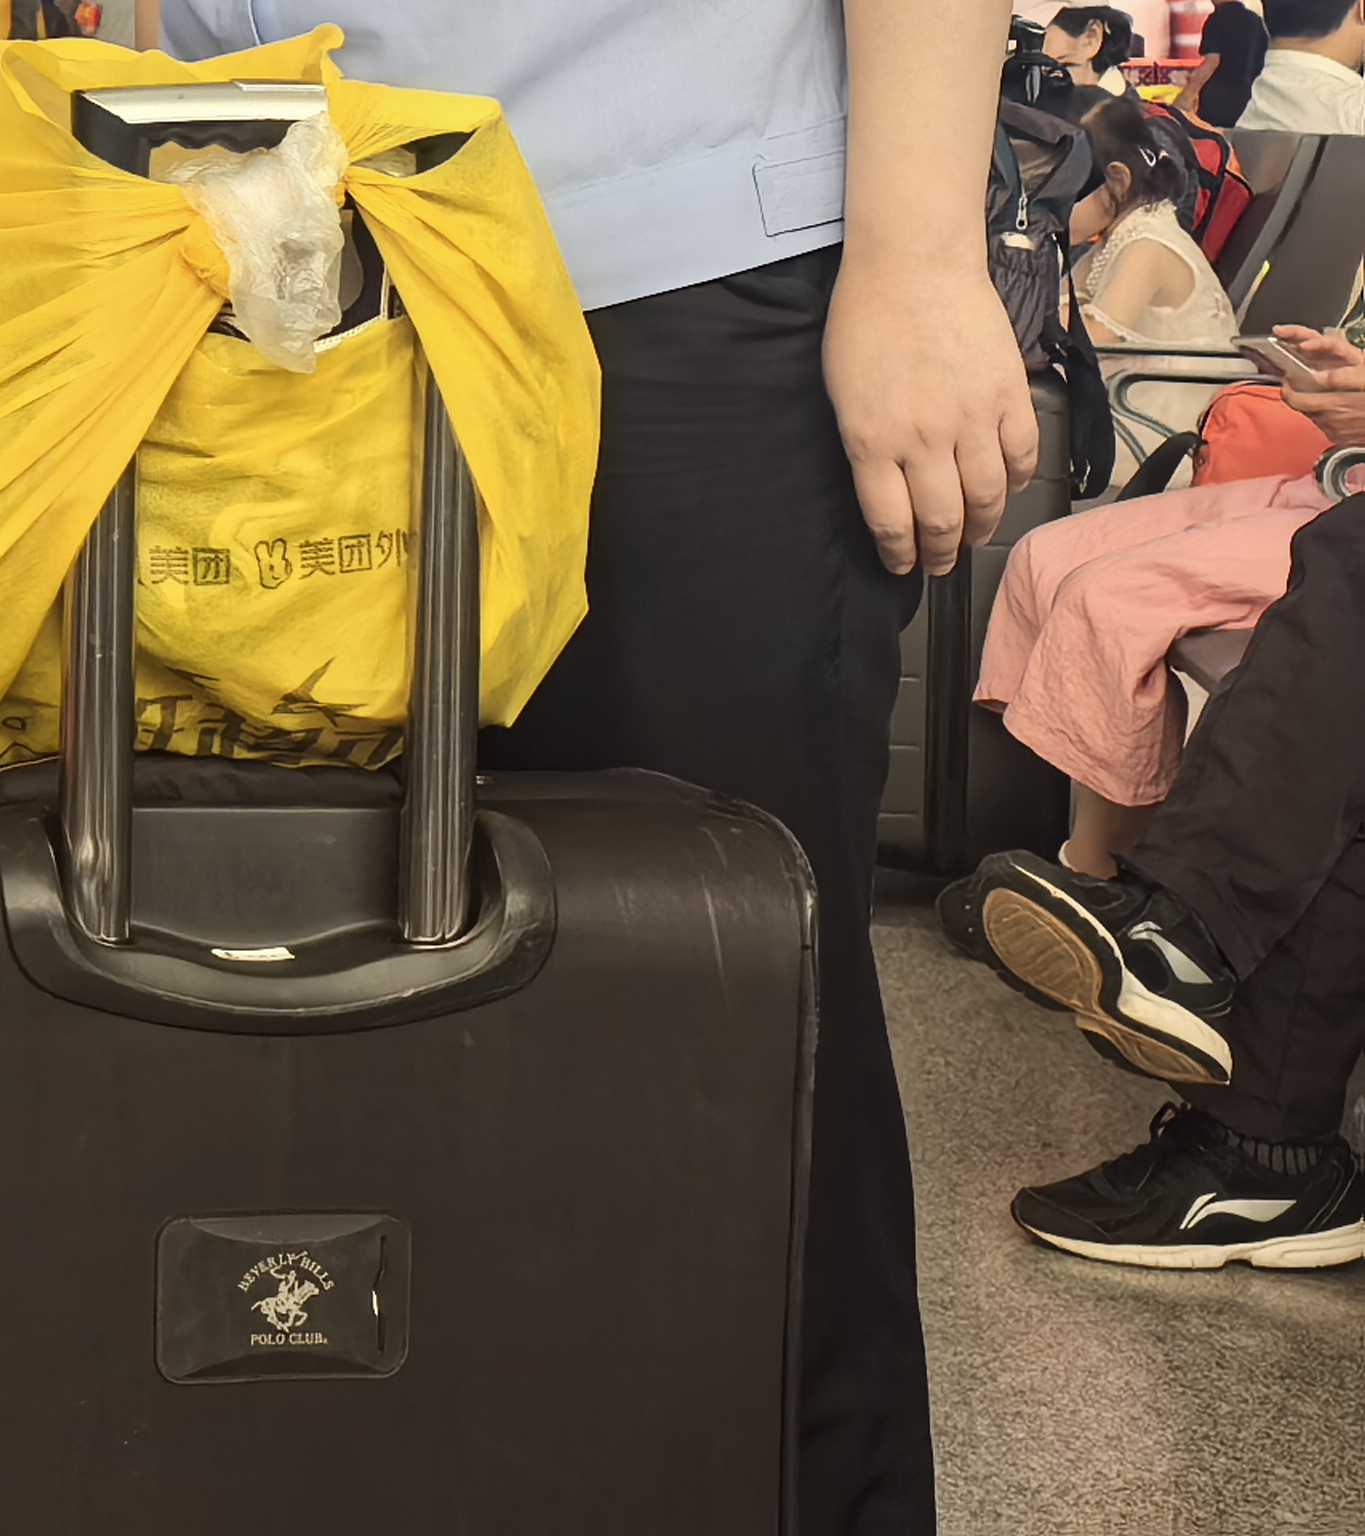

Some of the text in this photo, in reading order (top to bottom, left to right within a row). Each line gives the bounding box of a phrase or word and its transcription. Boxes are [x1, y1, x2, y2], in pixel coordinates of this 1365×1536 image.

[149, 545, 230, 586] 美团
[236, 1252, 335, 1294] BEVERLY HILLS
[250, 1332, 324, 1347] POLO CLUB
